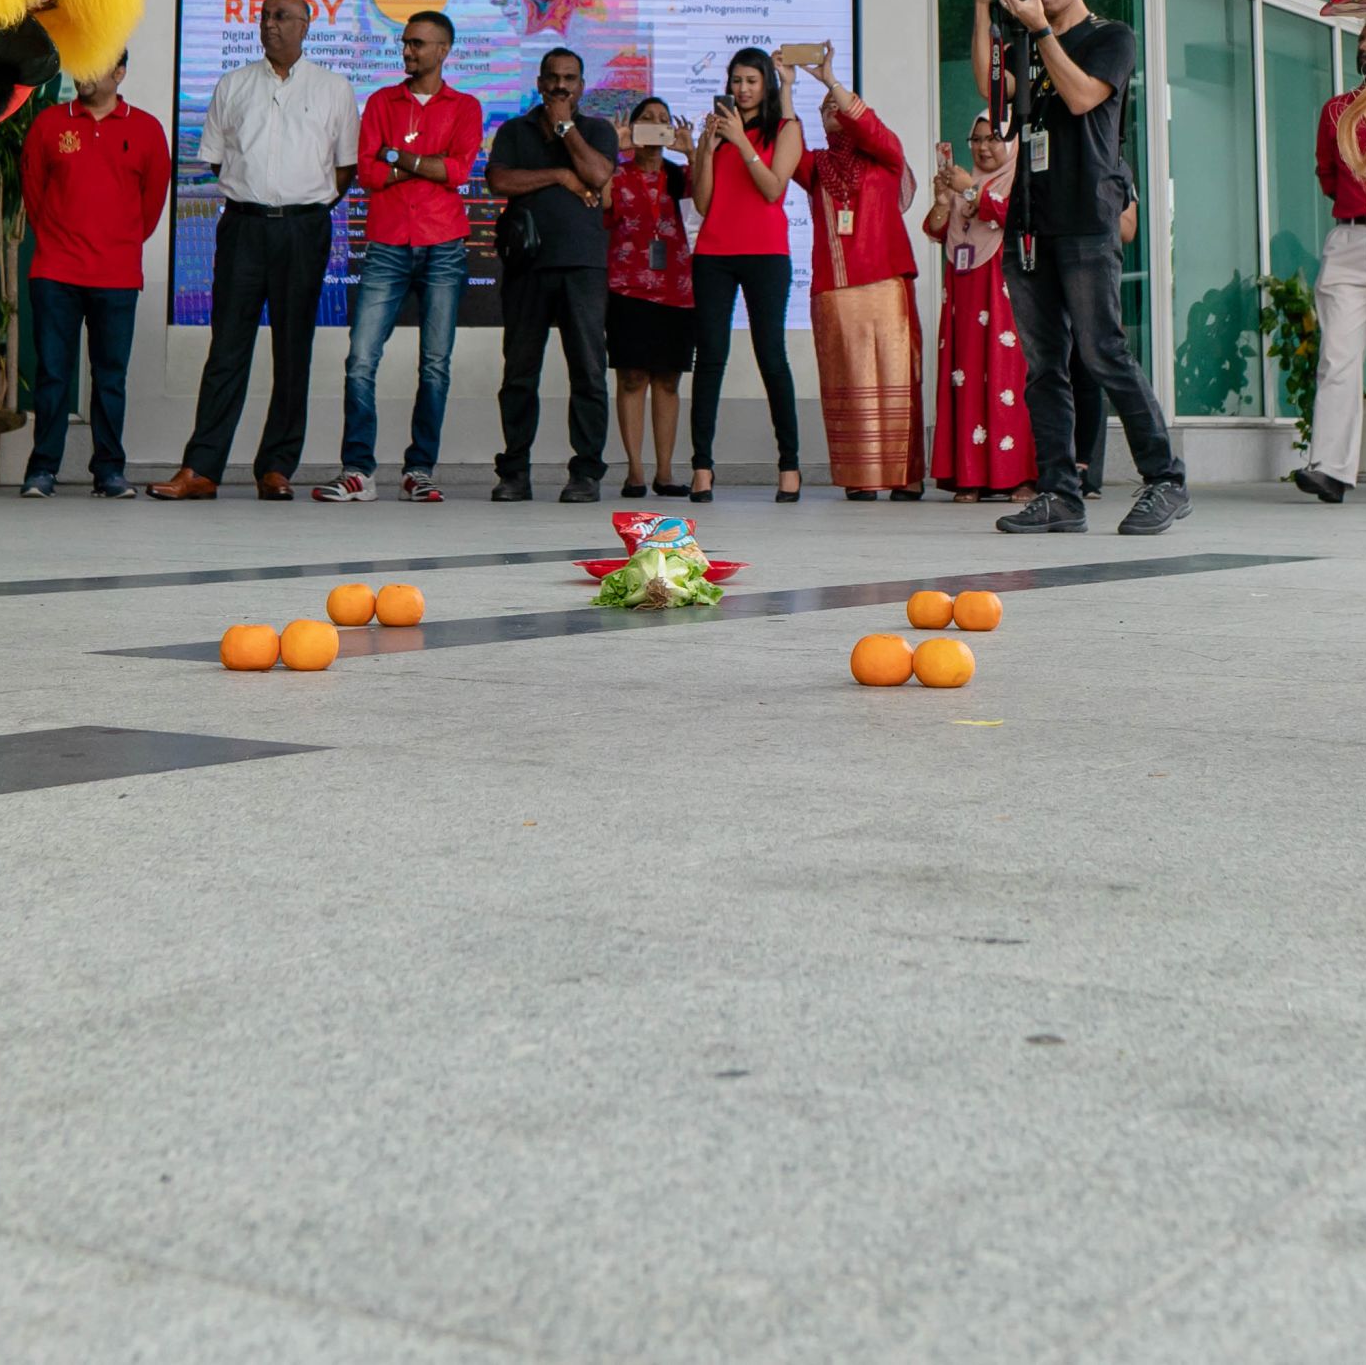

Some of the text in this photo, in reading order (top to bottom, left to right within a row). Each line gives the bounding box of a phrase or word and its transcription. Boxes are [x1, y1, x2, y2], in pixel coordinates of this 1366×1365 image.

[680, 4, 769, 17] Java Programming
[222, 30, 254, 42] Digital
[725, 35, 772, 45] WHY DTA
[222, 44, 253, 55] global
[310, 47, 355, 59] company
[992, 44, 1000, 65] EOS
